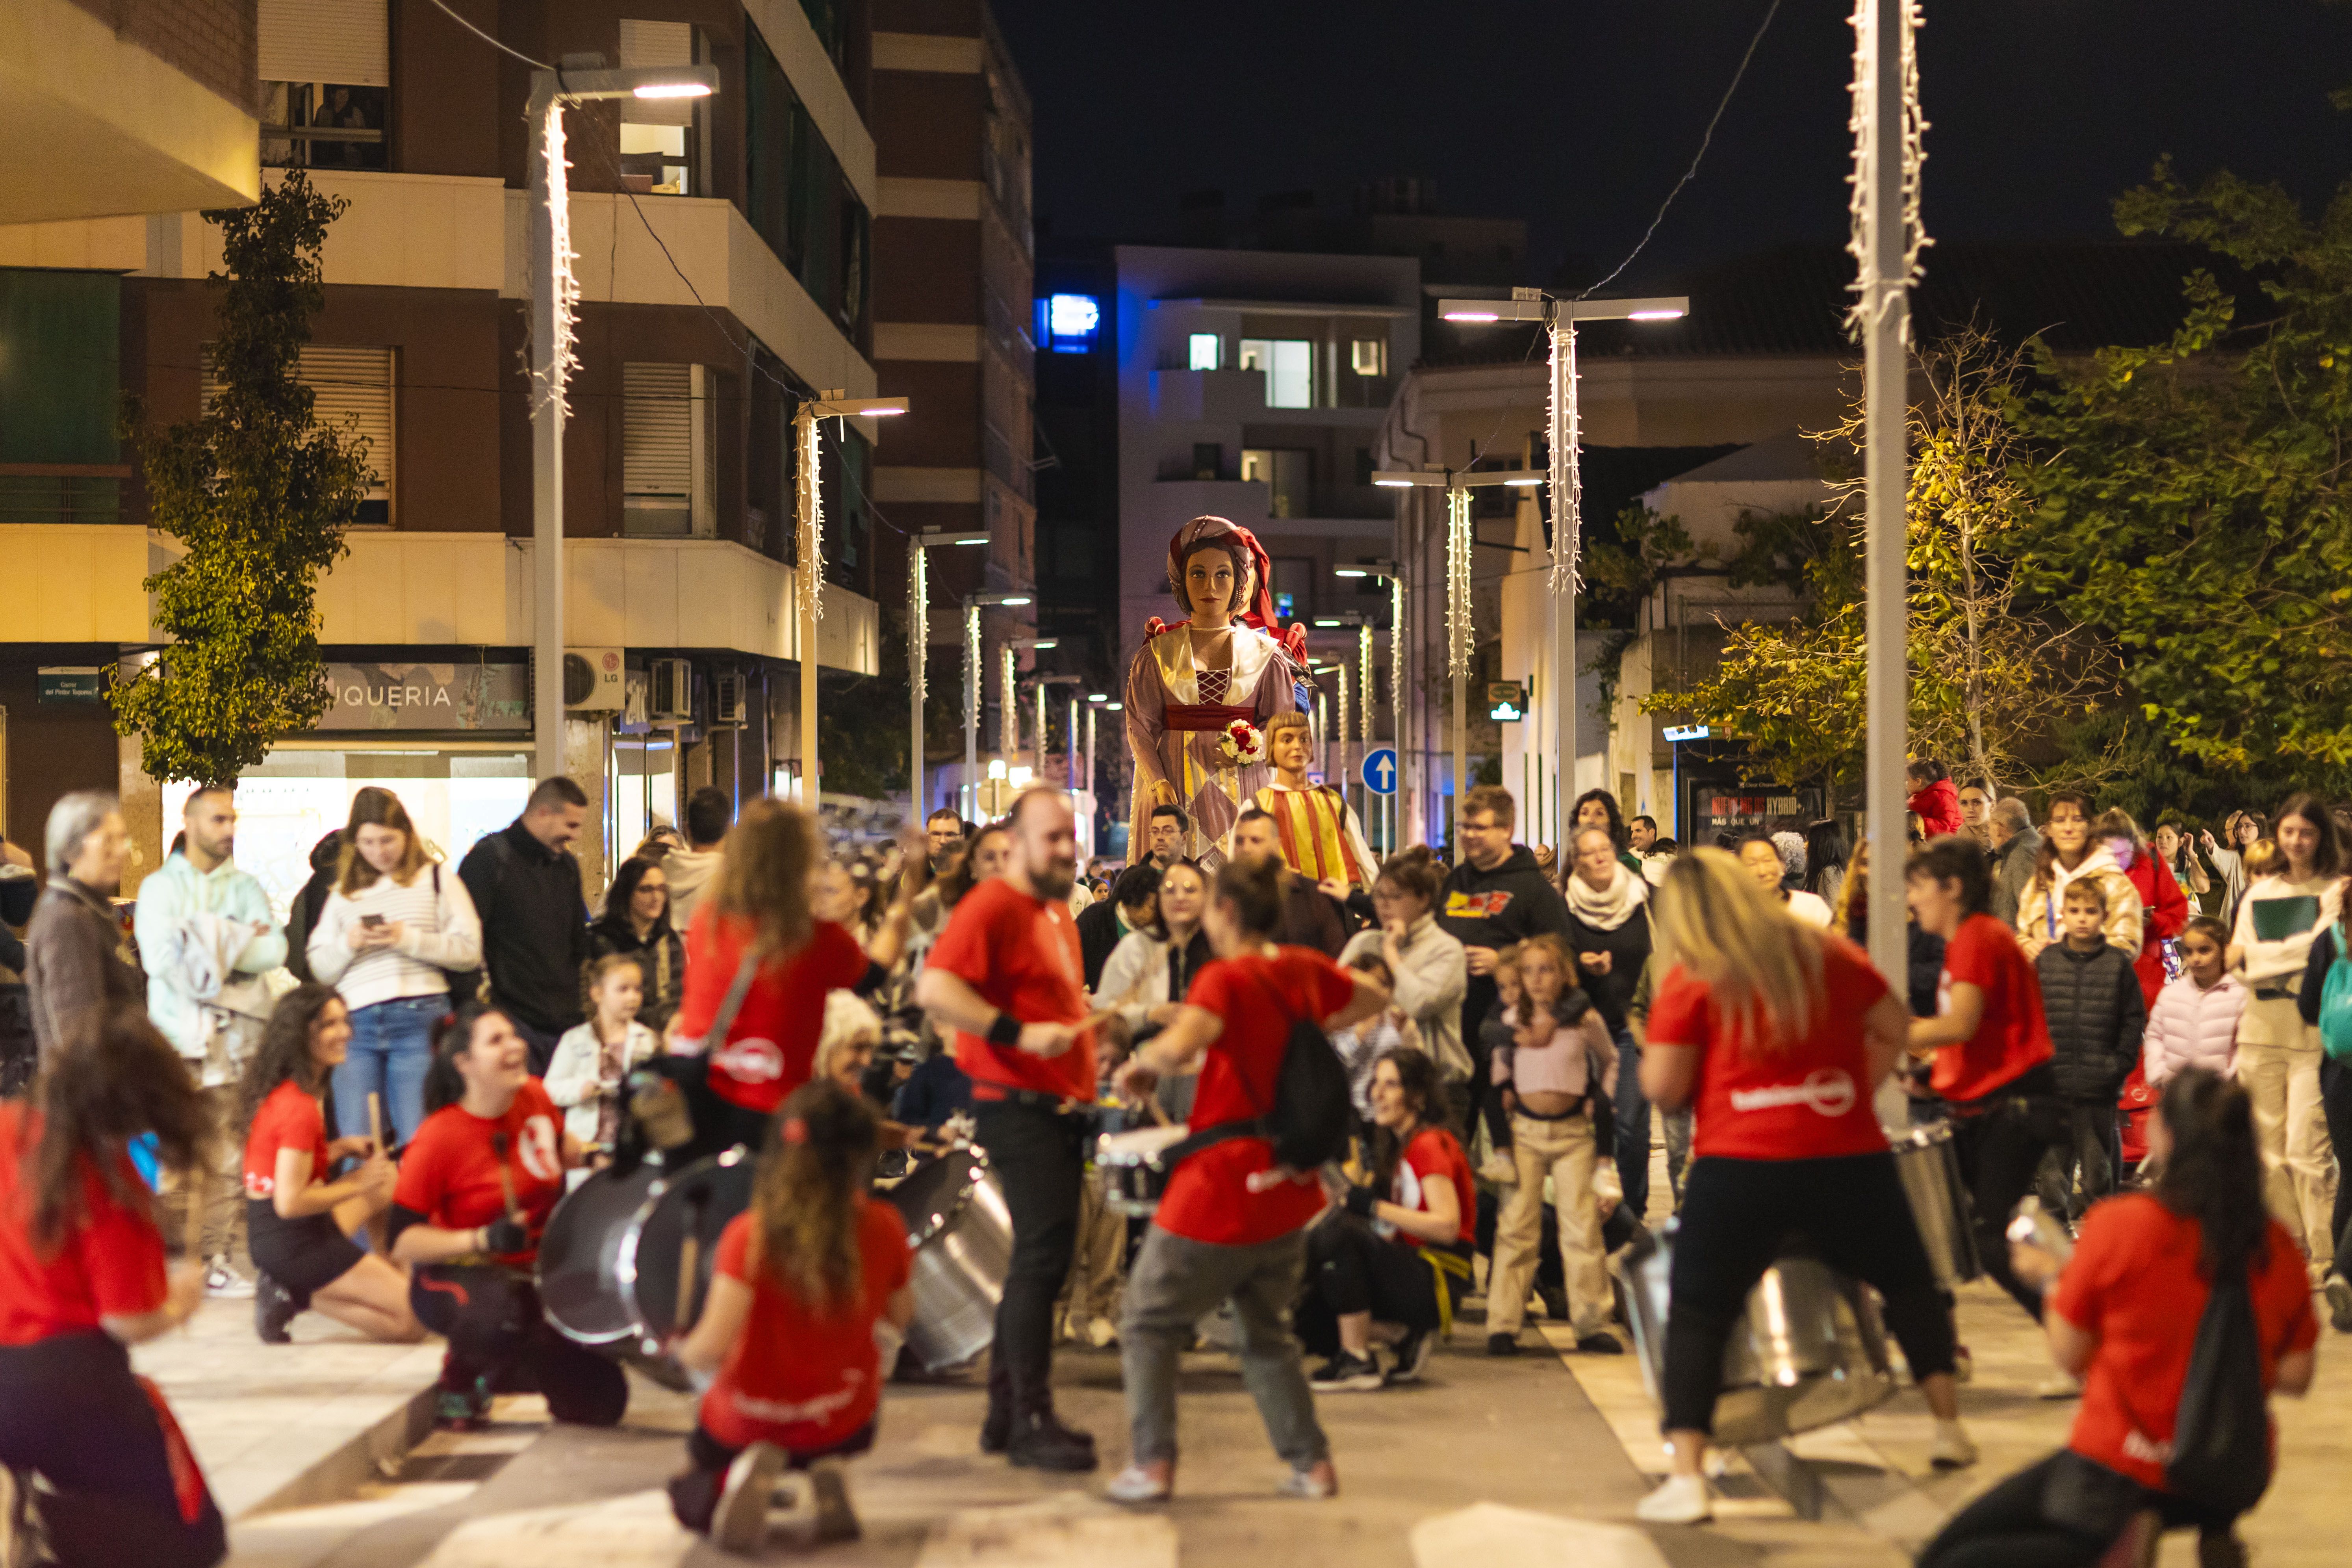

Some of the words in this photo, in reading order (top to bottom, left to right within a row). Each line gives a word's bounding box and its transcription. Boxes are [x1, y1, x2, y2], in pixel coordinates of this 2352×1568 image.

[605, 674, 618, 683] LG
[1740, 797, 1752, 815] MG
[1712, 817, 1726, 826] MÁS
